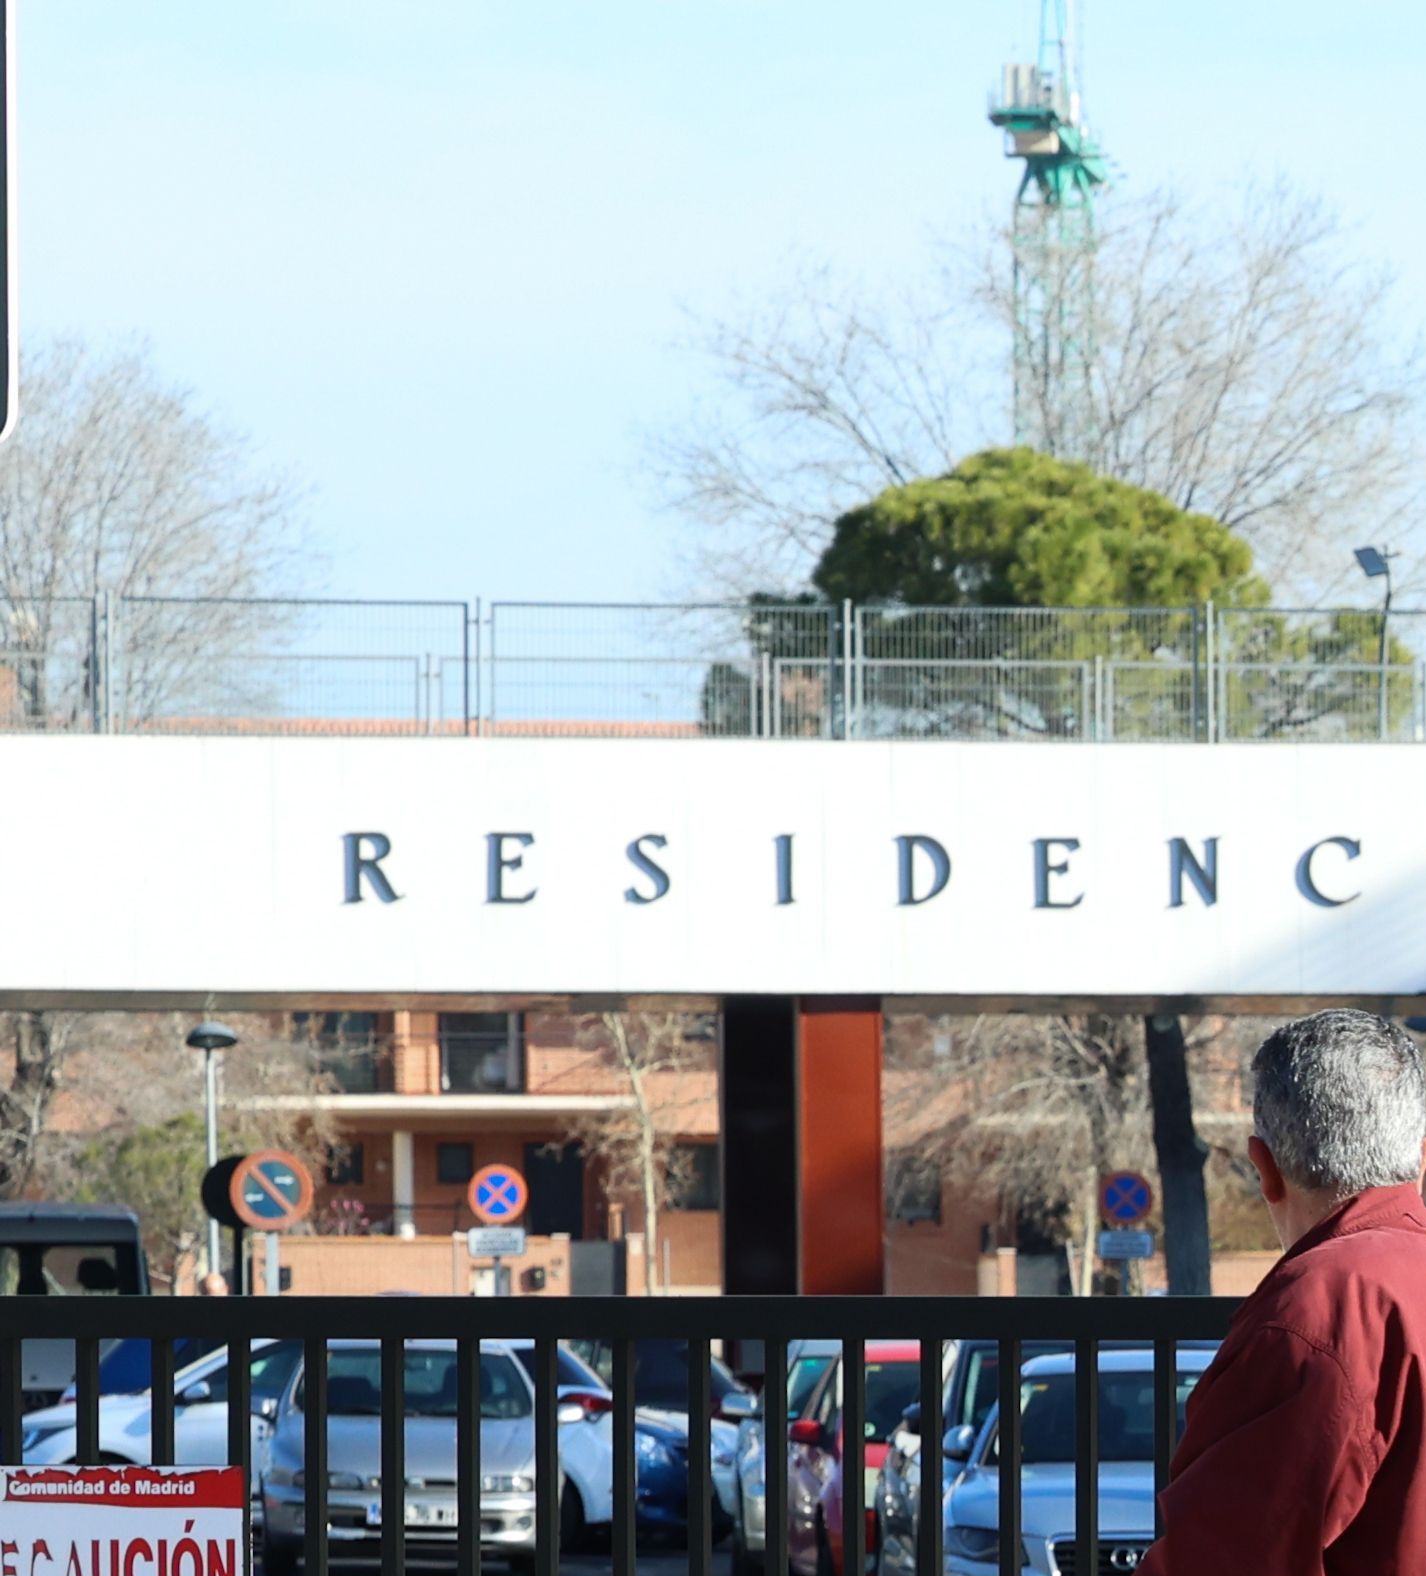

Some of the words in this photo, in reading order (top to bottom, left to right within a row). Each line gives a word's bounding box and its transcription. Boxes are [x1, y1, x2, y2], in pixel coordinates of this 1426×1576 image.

[9, 1480, 105, 1495] Comunidad
[109, 1481, 131, 1495] de
[135, 1480, 195, 1495] Madrid
